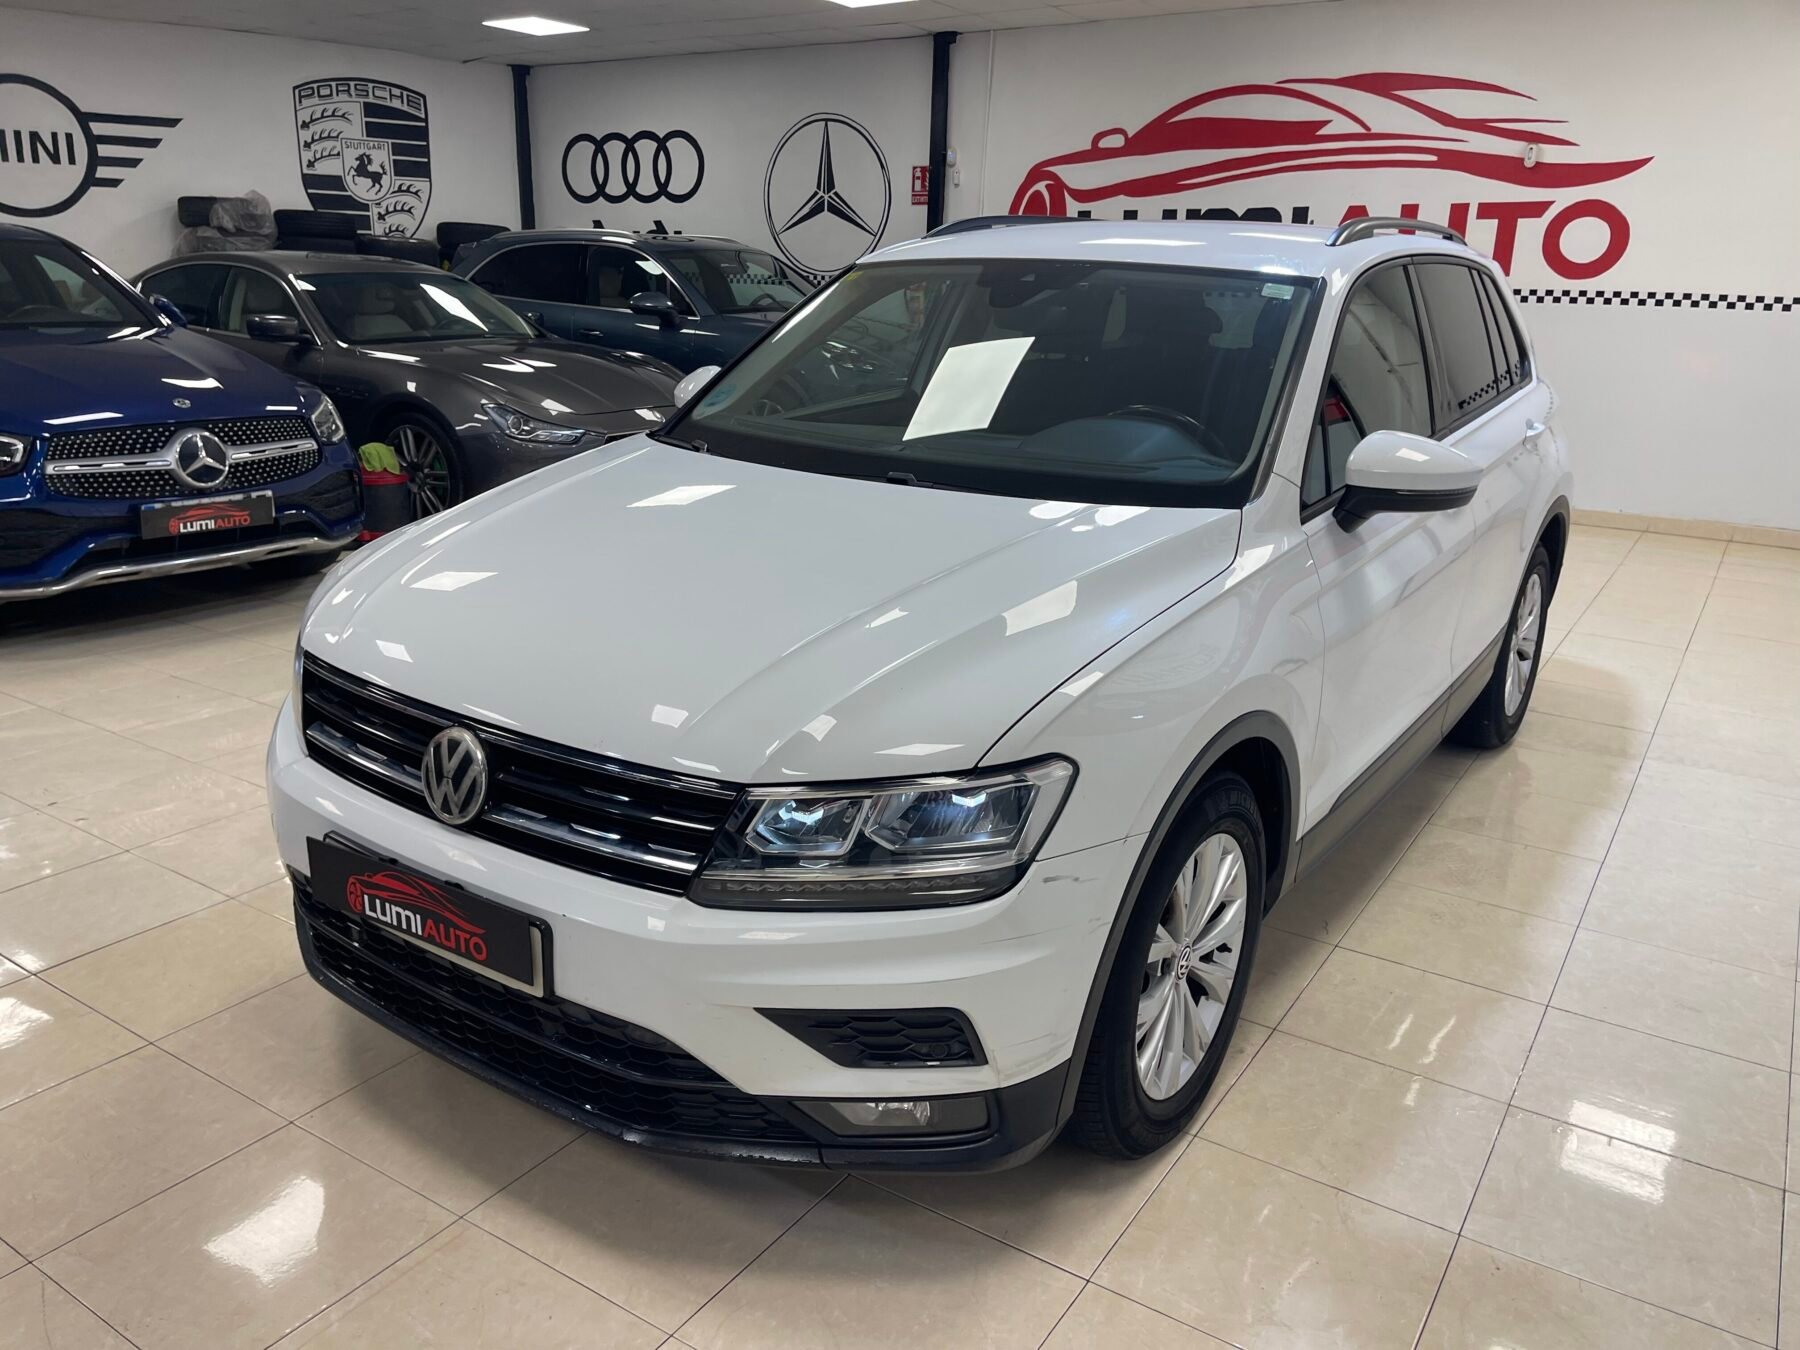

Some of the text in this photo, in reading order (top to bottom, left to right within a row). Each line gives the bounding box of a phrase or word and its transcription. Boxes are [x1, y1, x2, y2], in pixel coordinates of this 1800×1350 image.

[298, 83, 423, 115] PORSCHE
[344, 141, 386, 151] STUTTGART
[423, 730, 485, 822] VW
